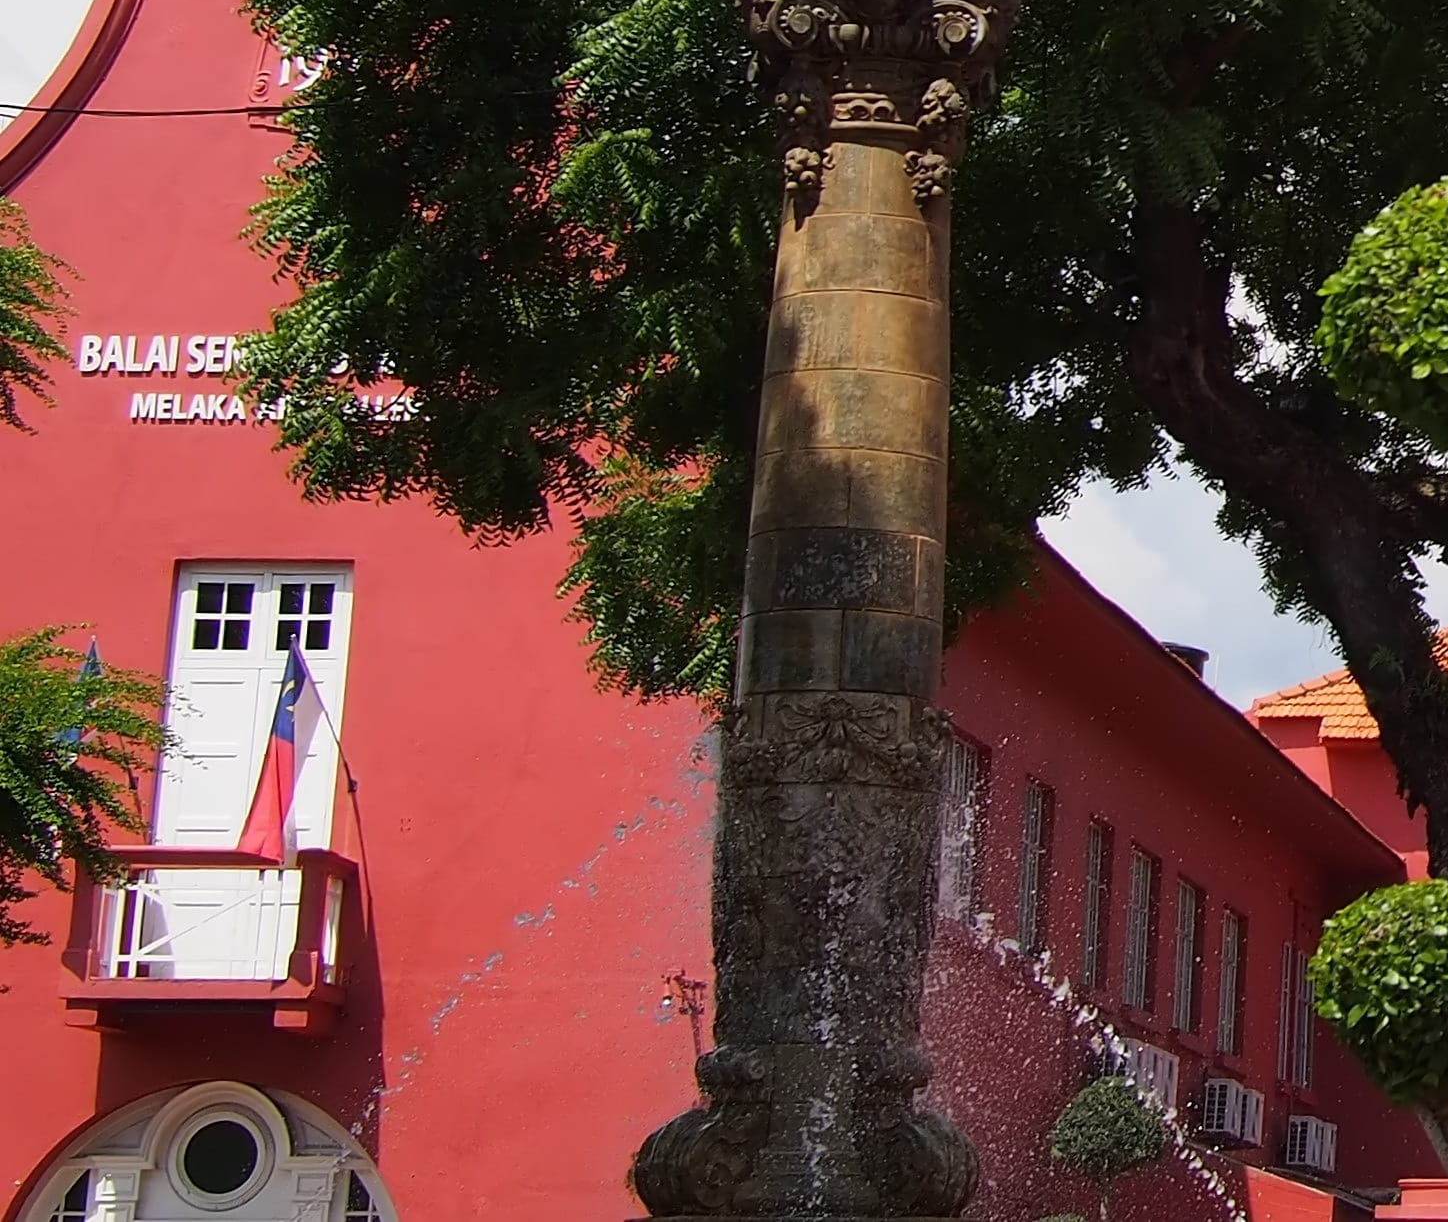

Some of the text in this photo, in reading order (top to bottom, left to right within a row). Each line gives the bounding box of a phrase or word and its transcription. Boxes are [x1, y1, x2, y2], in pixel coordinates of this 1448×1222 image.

[79, 334, 179, 373] BALAI
[186, 334, 256, 374] SEN
[130, 392, 246, 420] MELAKA
